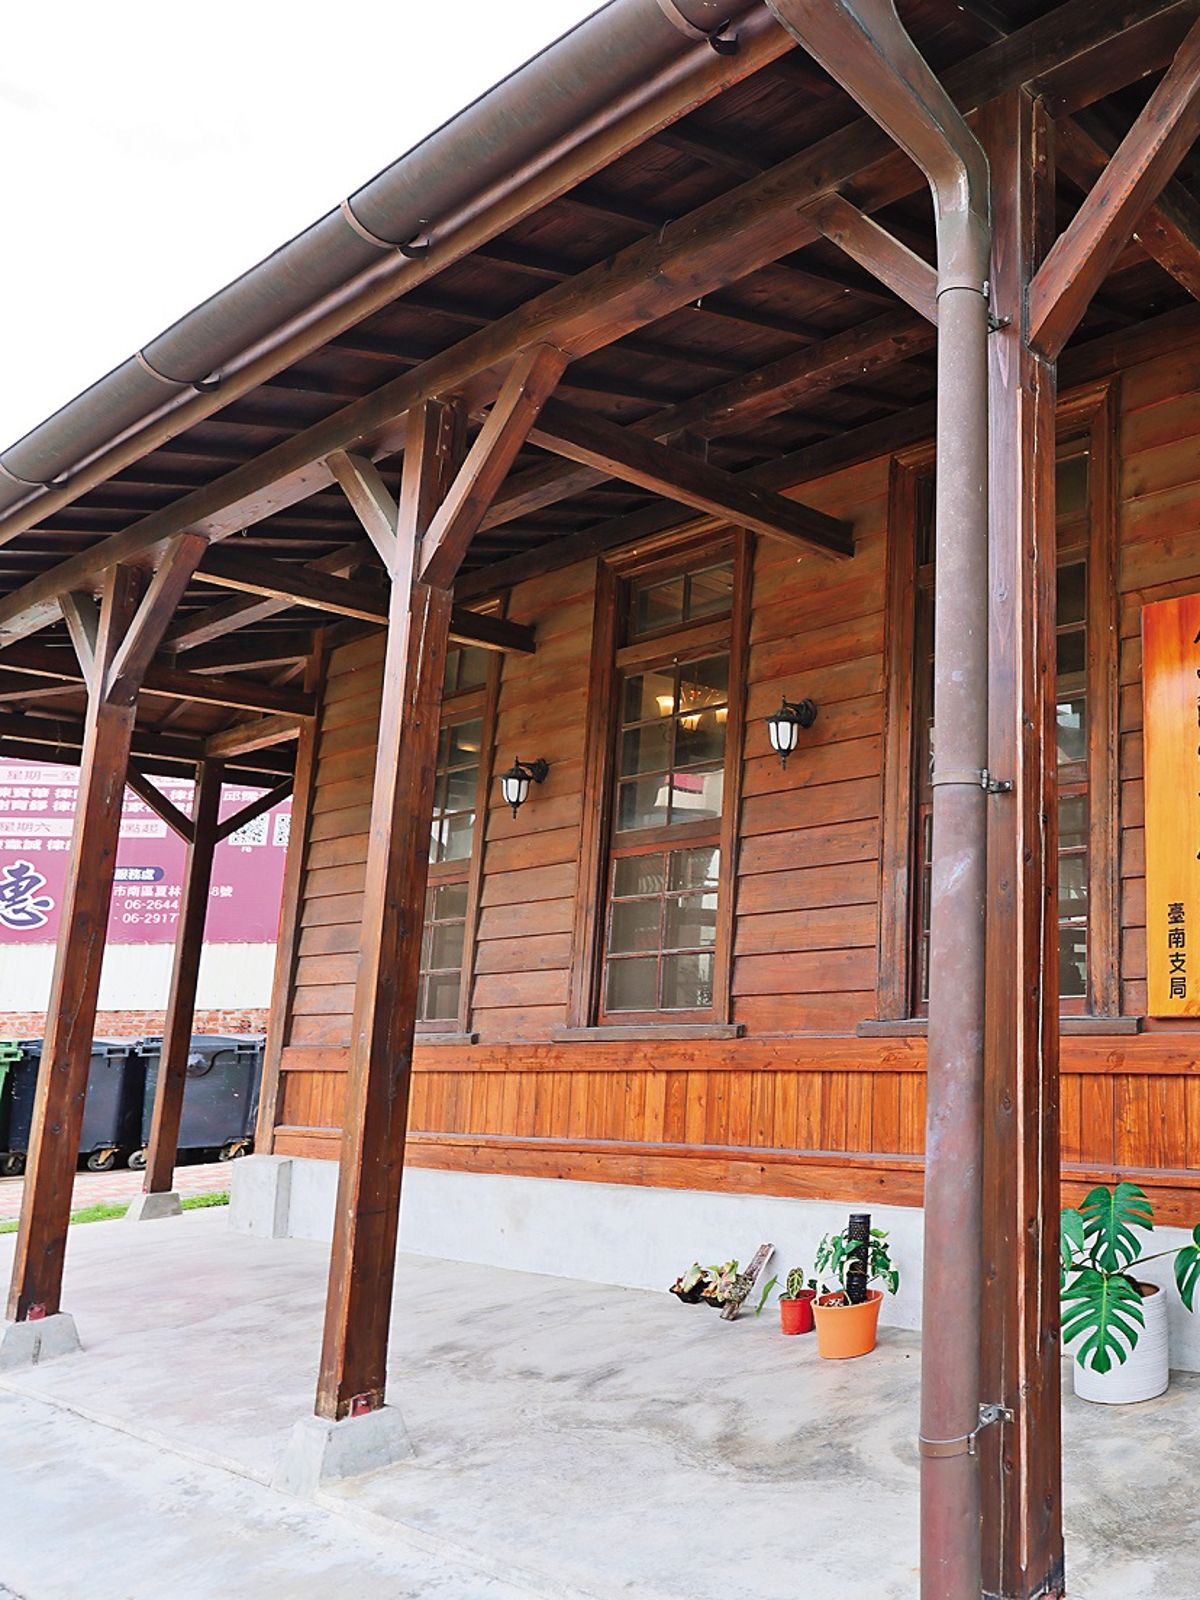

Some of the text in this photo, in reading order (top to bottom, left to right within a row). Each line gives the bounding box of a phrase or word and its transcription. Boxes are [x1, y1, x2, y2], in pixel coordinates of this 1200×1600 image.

[208, 886, 233, 897] 8號
[122, 913, 180, 923] 06-2917
[1167, 902, 1188, 1000] 臺南支局
